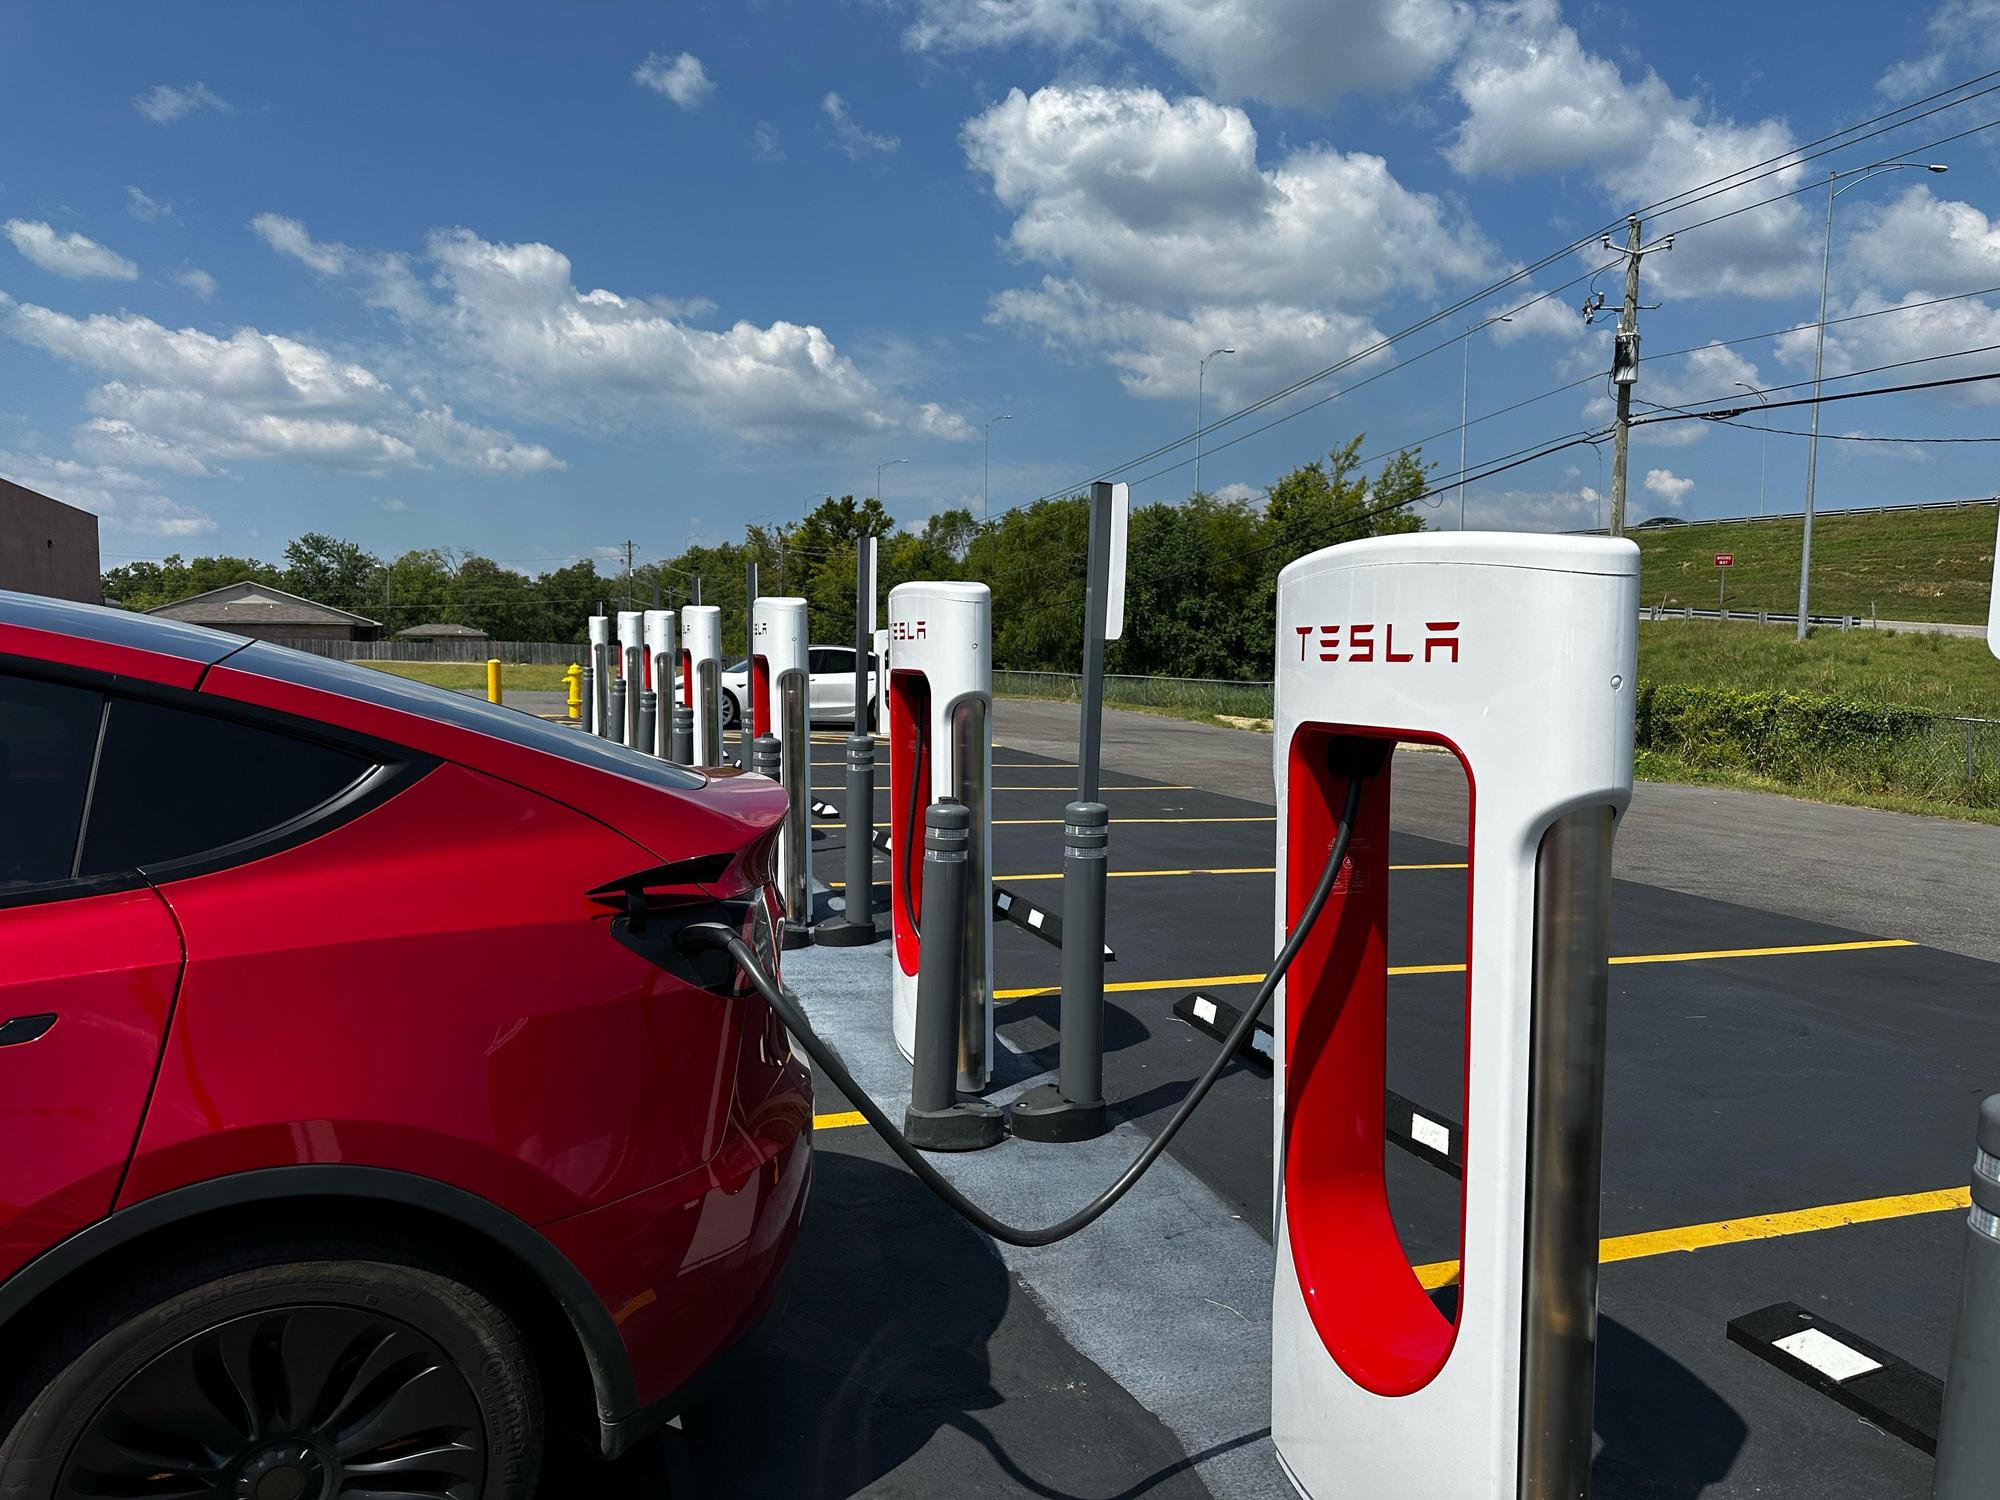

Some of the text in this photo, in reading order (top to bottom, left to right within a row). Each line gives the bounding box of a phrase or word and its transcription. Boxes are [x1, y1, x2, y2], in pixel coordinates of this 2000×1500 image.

[754, 621, 767, 636] SLA
[890, 621, 926, 640] ESLA
[1295, 621, 1460, 663] TESLA
